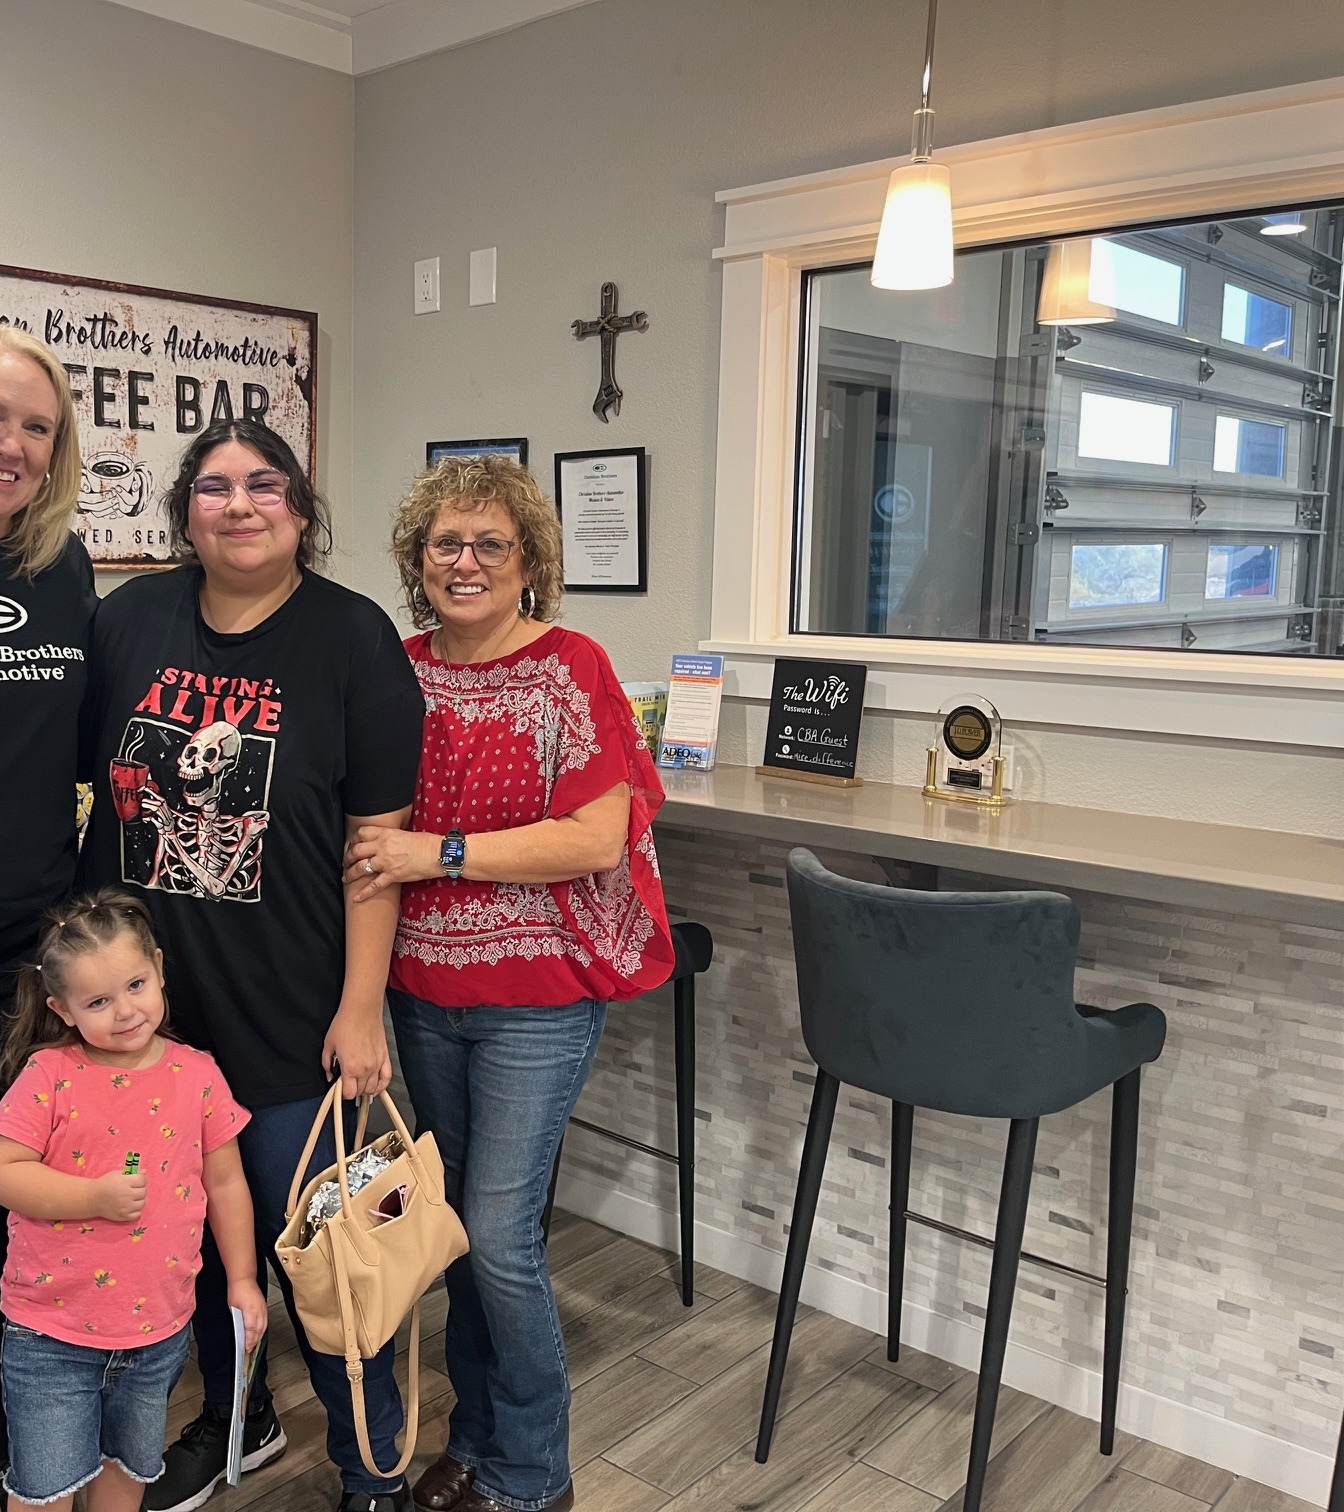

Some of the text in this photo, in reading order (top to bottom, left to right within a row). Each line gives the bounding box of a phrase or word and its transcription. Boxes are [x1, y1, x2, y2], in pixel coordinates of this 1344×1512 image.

[44, 308, 153, 356] Brothers
[164, 325, 282, 368] Automotive
[176, 375, 270, 435] BAR
[76, 528, 166, 544] WED. SER
[161, 667, 274, 697] STAYING
[783, 677, 849, 709] The Wifi
[134, 683, 282, 732] ALIVE
[783, 704, 811, 714] Password
[797, 727, 817, 742] CBA
[820, 728, 848, 746] Guest
[662, 747, 691, 758] ADEQ
